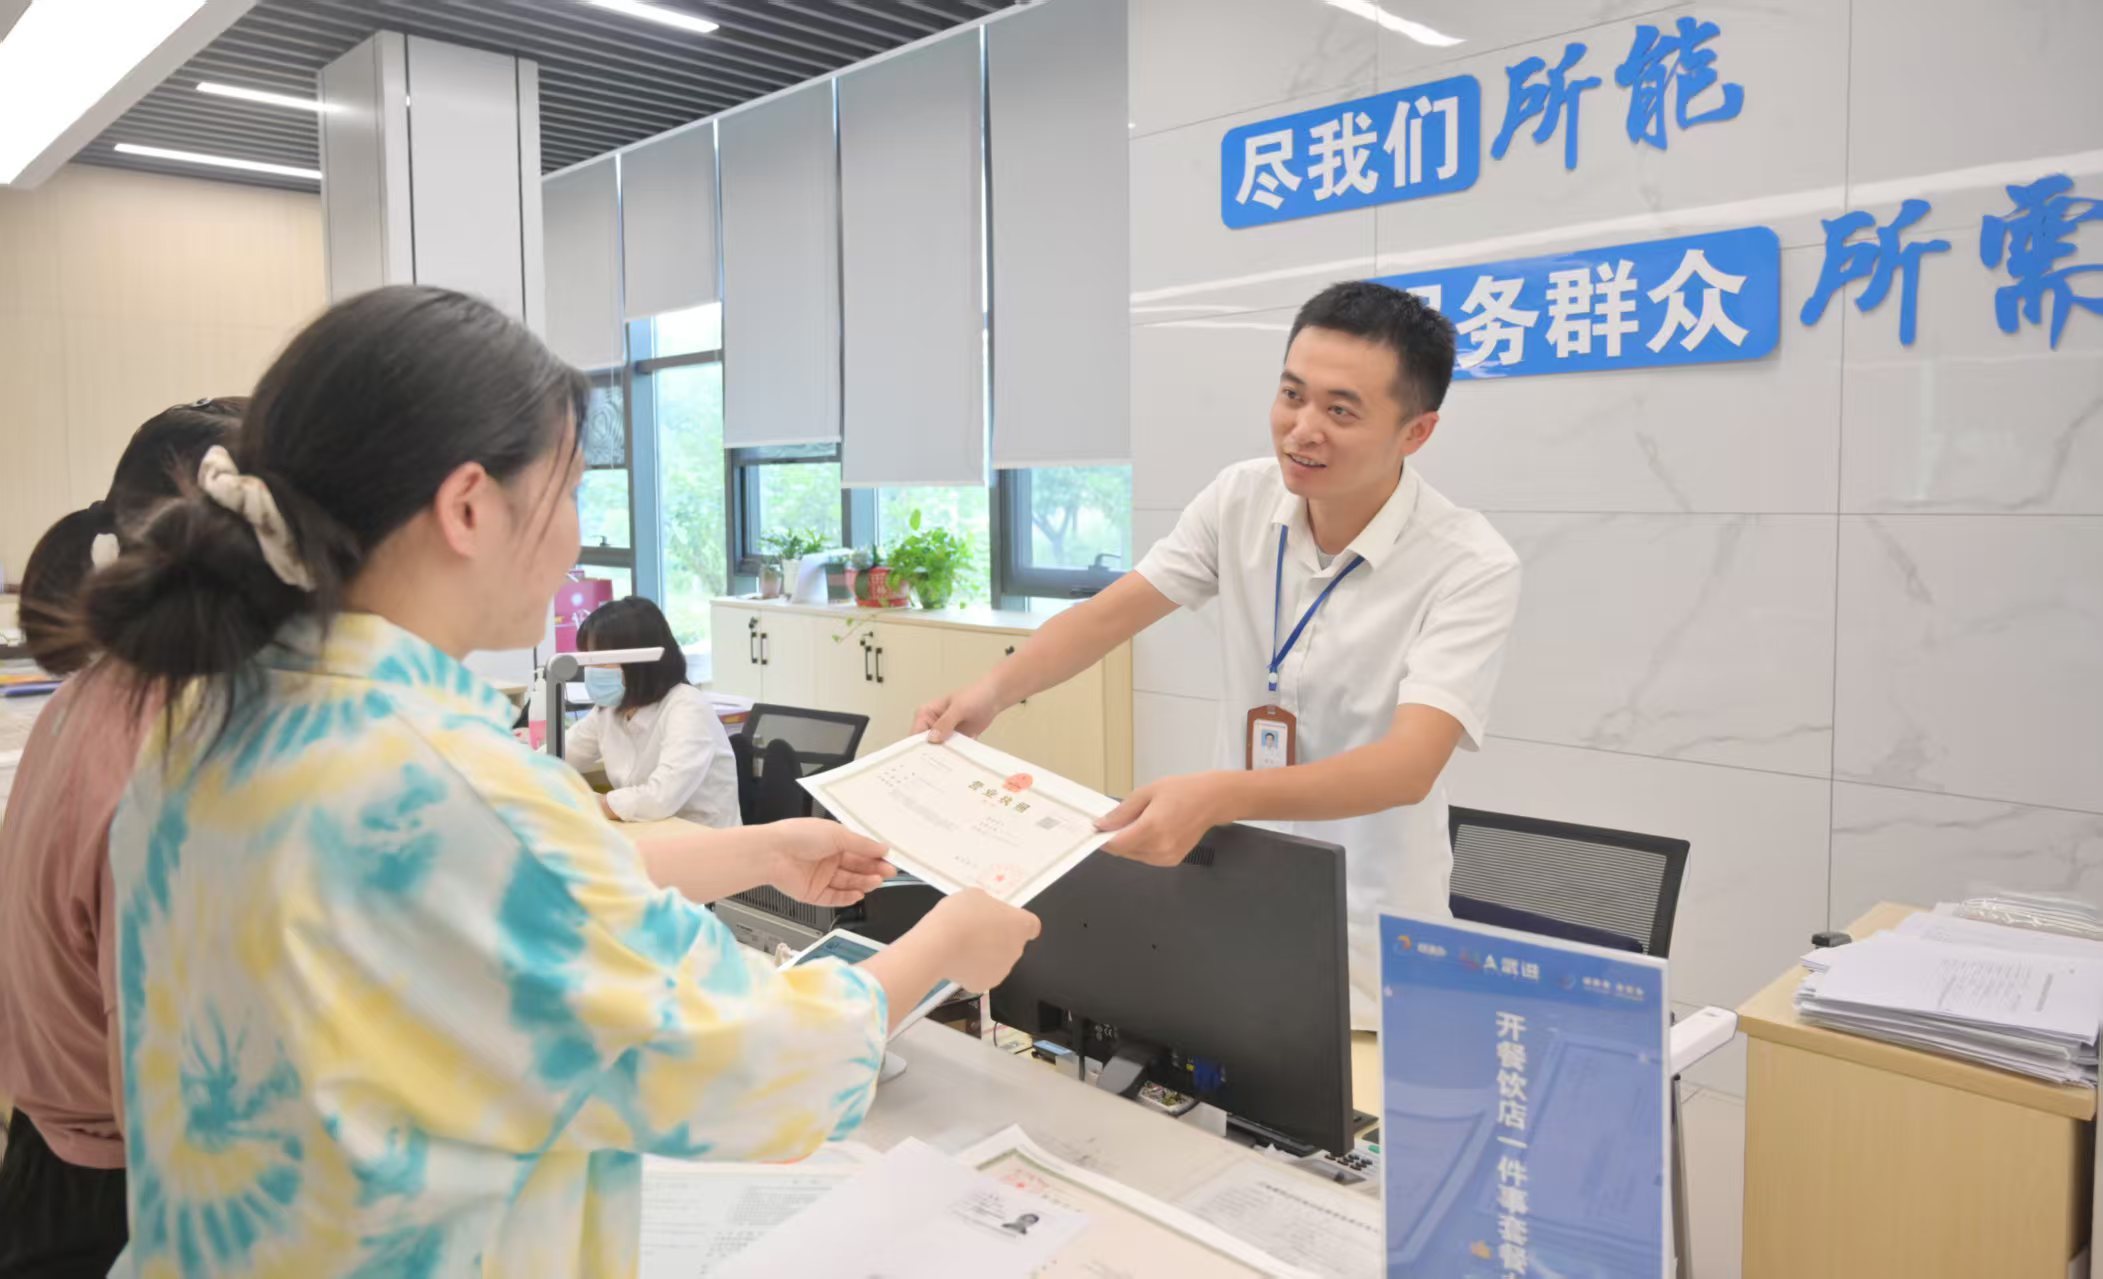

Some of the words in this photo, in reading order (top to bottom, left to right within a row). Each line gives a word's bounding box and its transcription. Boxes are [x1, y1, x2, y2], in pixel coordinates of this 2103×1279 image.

[1234, 95, 1458, 210] 尽我们
[1491, 17, 1745, 170] 所能
[1404, 248, 1750, 371] 务群众
[1496, 1011, 1528, 1279] 开餐饮店一件事套餐
